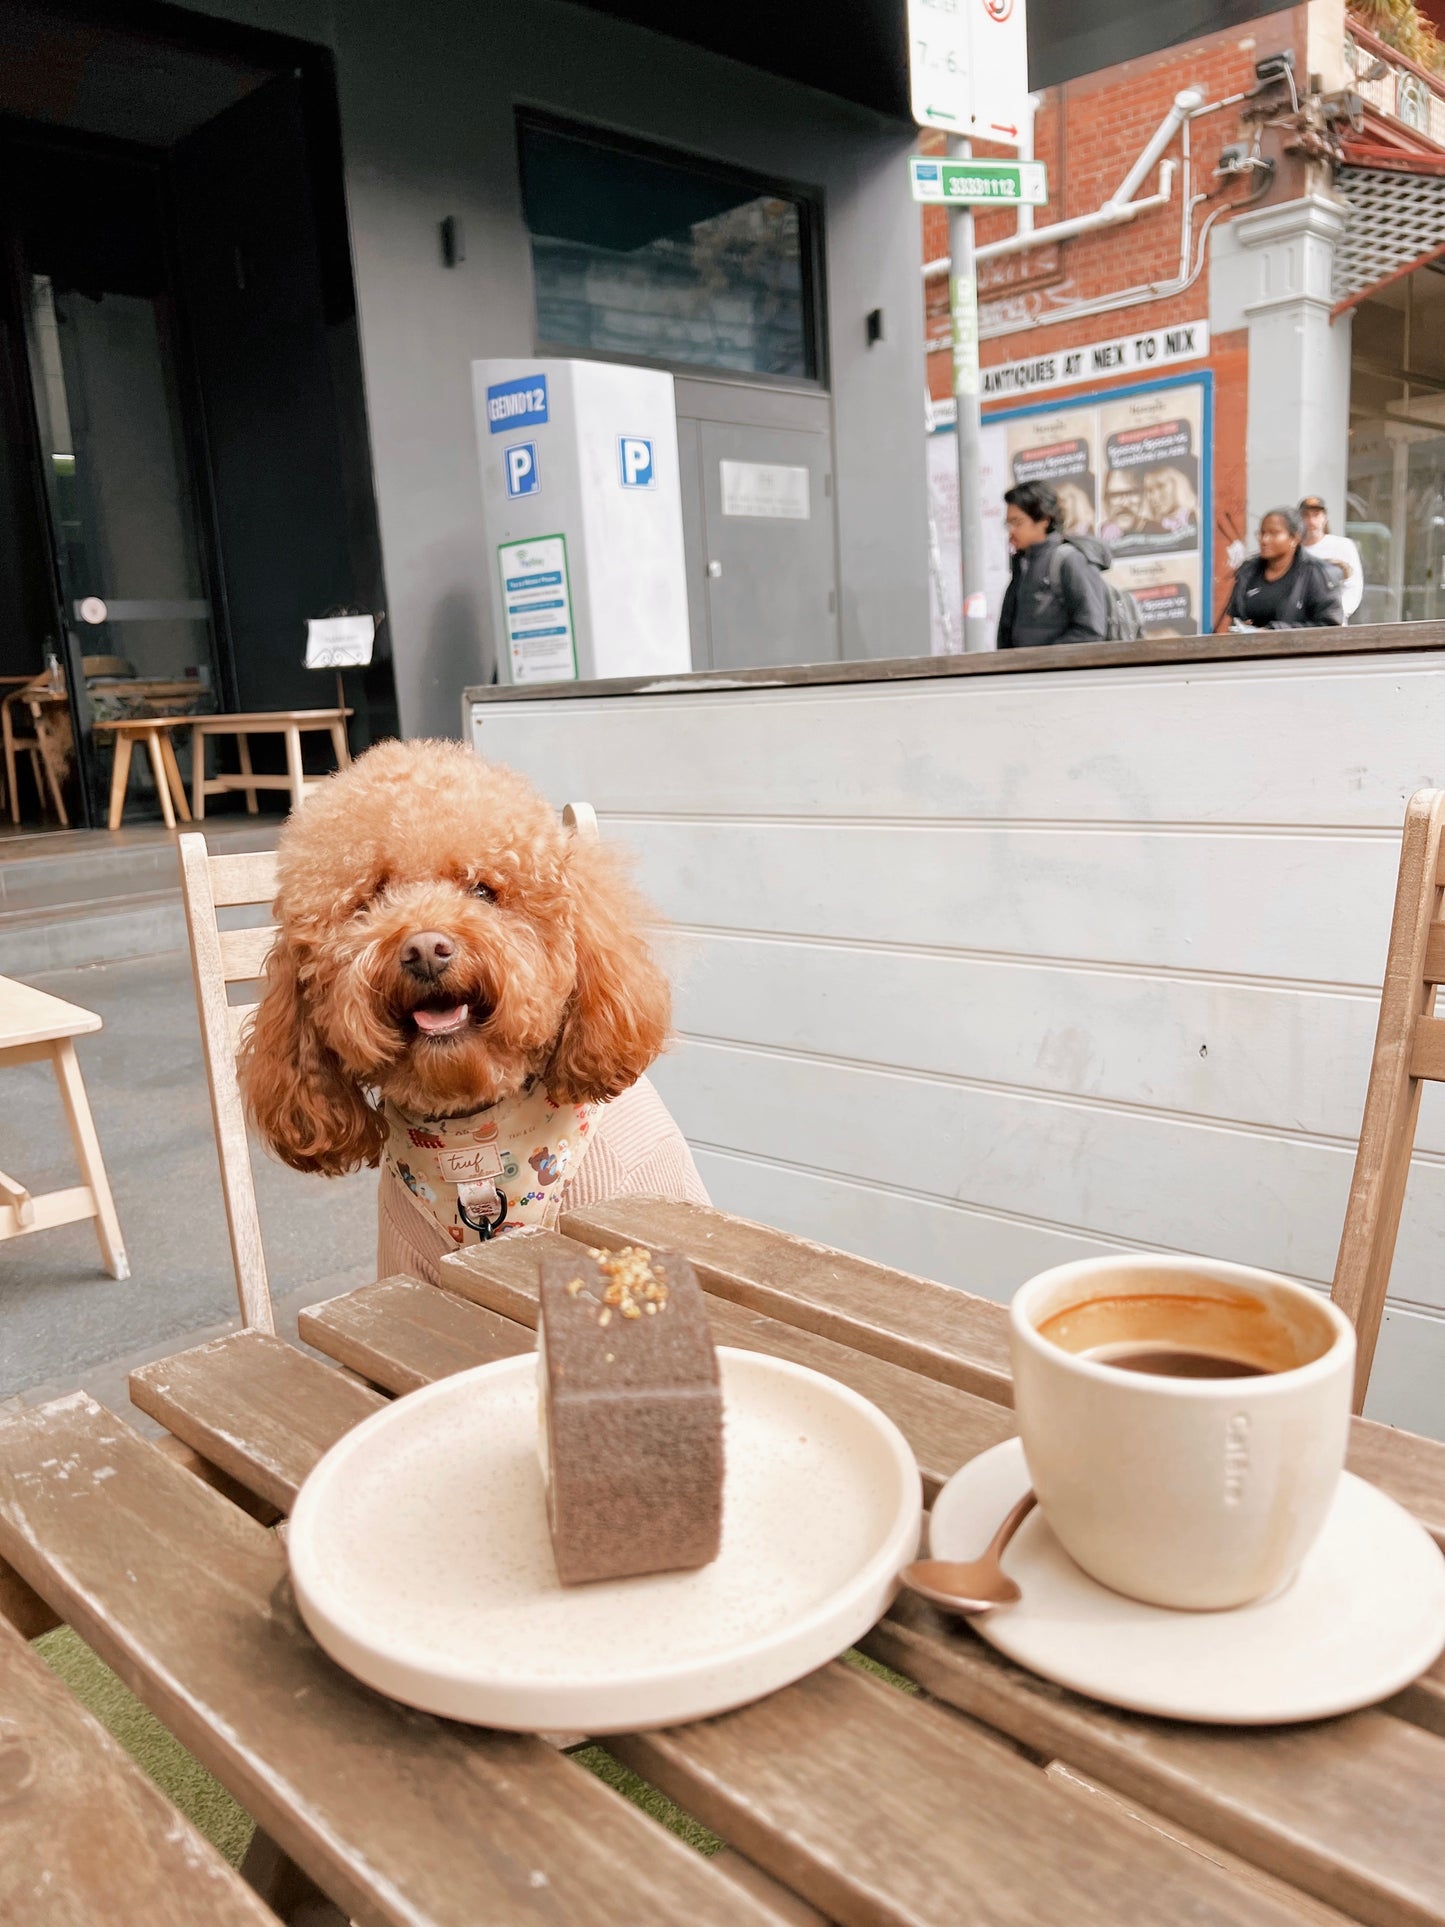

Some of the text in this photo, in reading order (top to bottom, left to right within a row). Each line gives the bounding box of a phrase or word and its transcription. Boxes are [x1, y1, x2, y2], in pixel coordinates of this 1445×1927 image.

[984, 359, 1055, 393] ANTIQUES
[1064, 353, 1082, 375] AT
[1135, 337, 1156, 360] TO
[508, 448, 532, 493] P
[624, 440, 651, 484] P
[448, 1153, 484, 1173] truf
